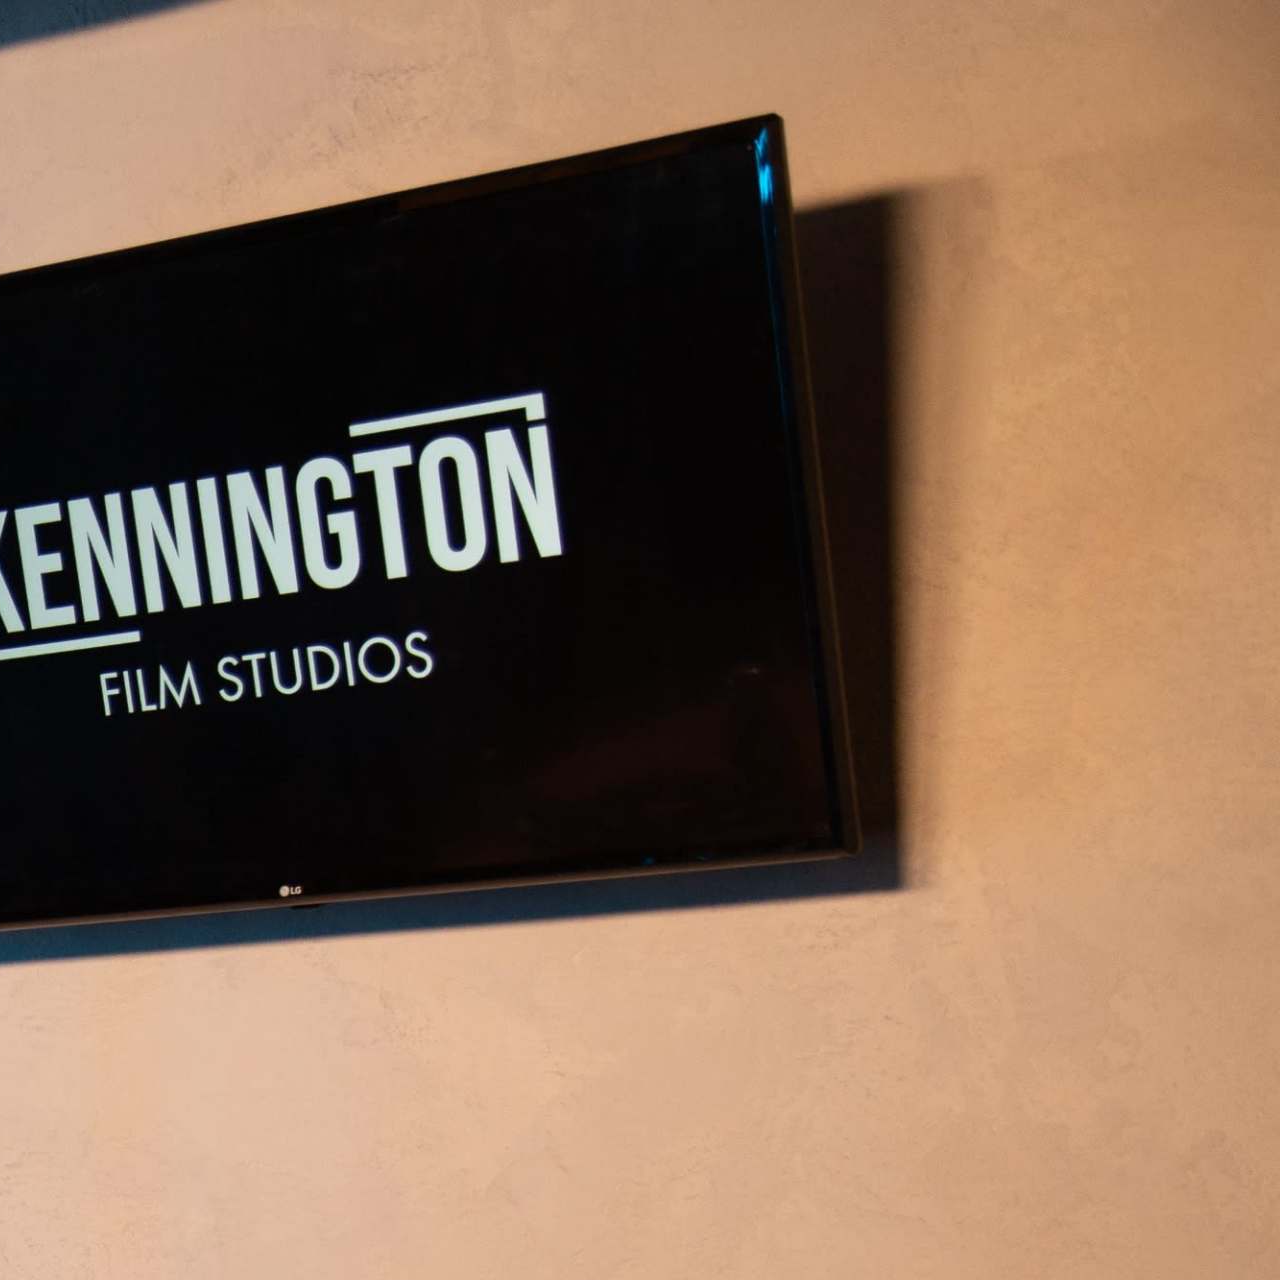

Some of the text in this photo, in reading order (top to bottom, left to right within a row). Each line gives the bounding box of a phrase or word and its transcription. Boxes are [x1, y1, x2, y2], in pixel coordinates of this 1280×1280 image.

[99, 631, 434, 717] FILM STUDIOS
[290, 886, 302, 895] LG
